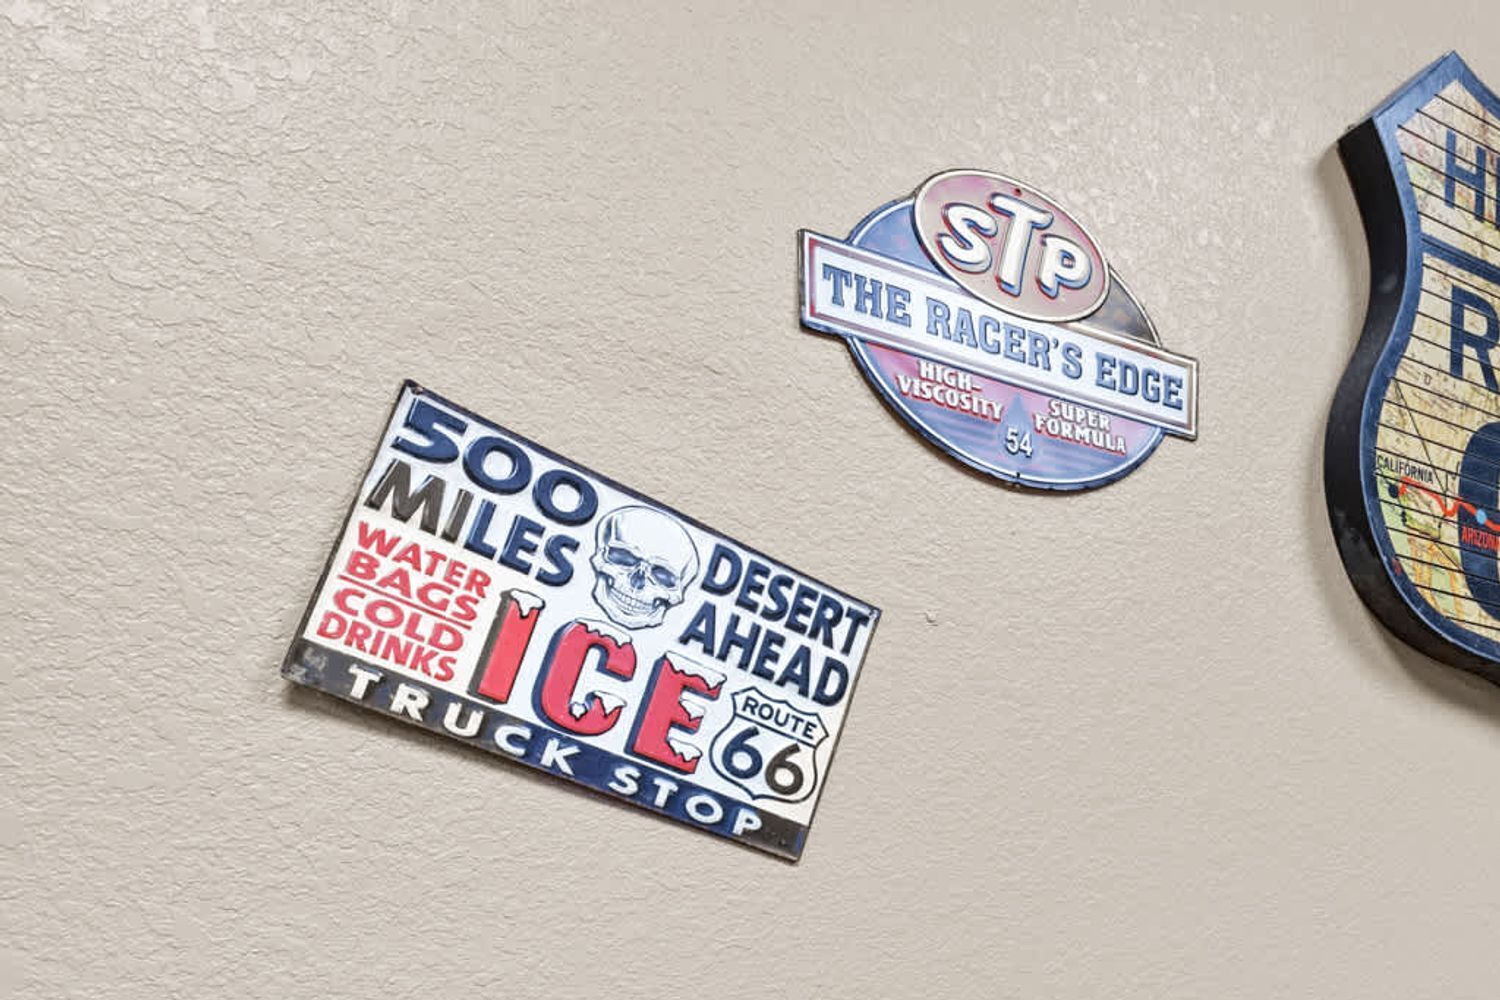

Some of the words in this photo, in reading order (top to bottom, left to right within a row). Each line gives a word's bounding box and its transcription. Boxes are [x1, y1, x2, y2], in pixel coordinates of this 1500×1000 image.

[936, 191, 1092, 300] STP
[822, 263, 912, 328] THE
[926, 296, 1084, 380] RACER'S
[1095, 352, 1183, 411] EDGE
[897, 374, 1003, 423] VISCOSITY
[918, 360, 982, 392] HIGH-
[1006, 426, 1033, 458] 54
[1033, 412, 1126, 455] FORMULA
[1048, 400, 1111, 431] SUPER
[391, 397, 599, 525] 500
[1377, 454, 1433, 484] CALIFORNIA
[365, 457, 580, 588] MILES
[345, 551, 480, 622] BAGS
[357, 520, 492, 599] WATER
[332, 587, 465, 652] COLD
[700, 543, 871, 656] DESERT
[316, 611, 456, 684] DRINKS
[467, 588, 728, 775] ICE
[679, 603, 849, 706] AHEAD
[348, 662, 580, 775] TRUCK
[608, 766, 762, 836] STOP
[741, 695, 818, 740] ROUTE
[720, 726, 803, 795] 66
